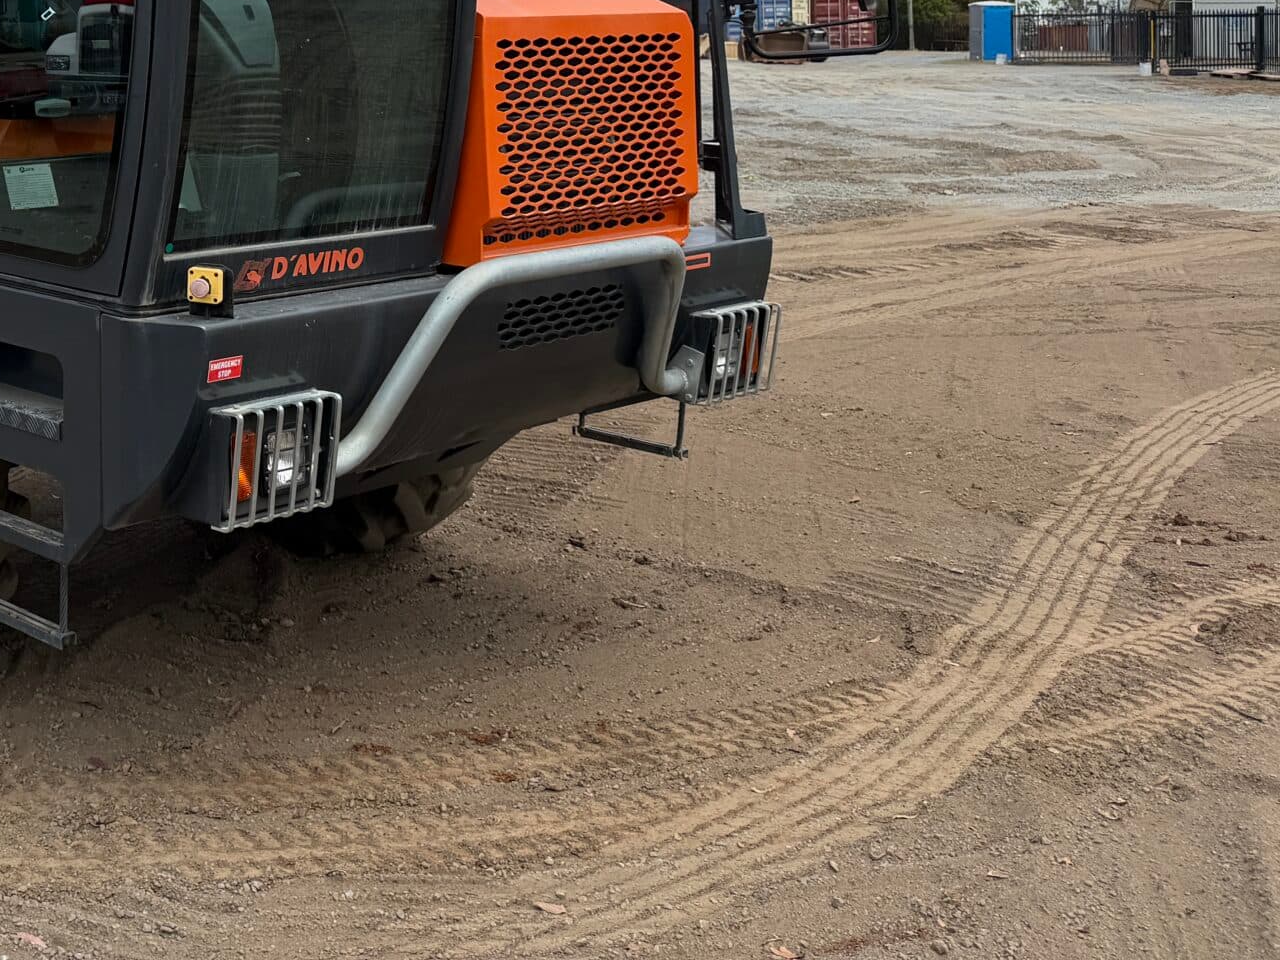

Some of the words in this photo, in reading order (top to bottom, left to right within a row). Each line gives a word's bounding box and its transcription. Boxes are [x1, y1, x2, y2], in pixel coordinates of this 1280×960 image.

[271, 247, 365, 280] D'AVINO
[210, 360, 241, 371] EMERGENCY
[217, 369, 232, 379] STOP
